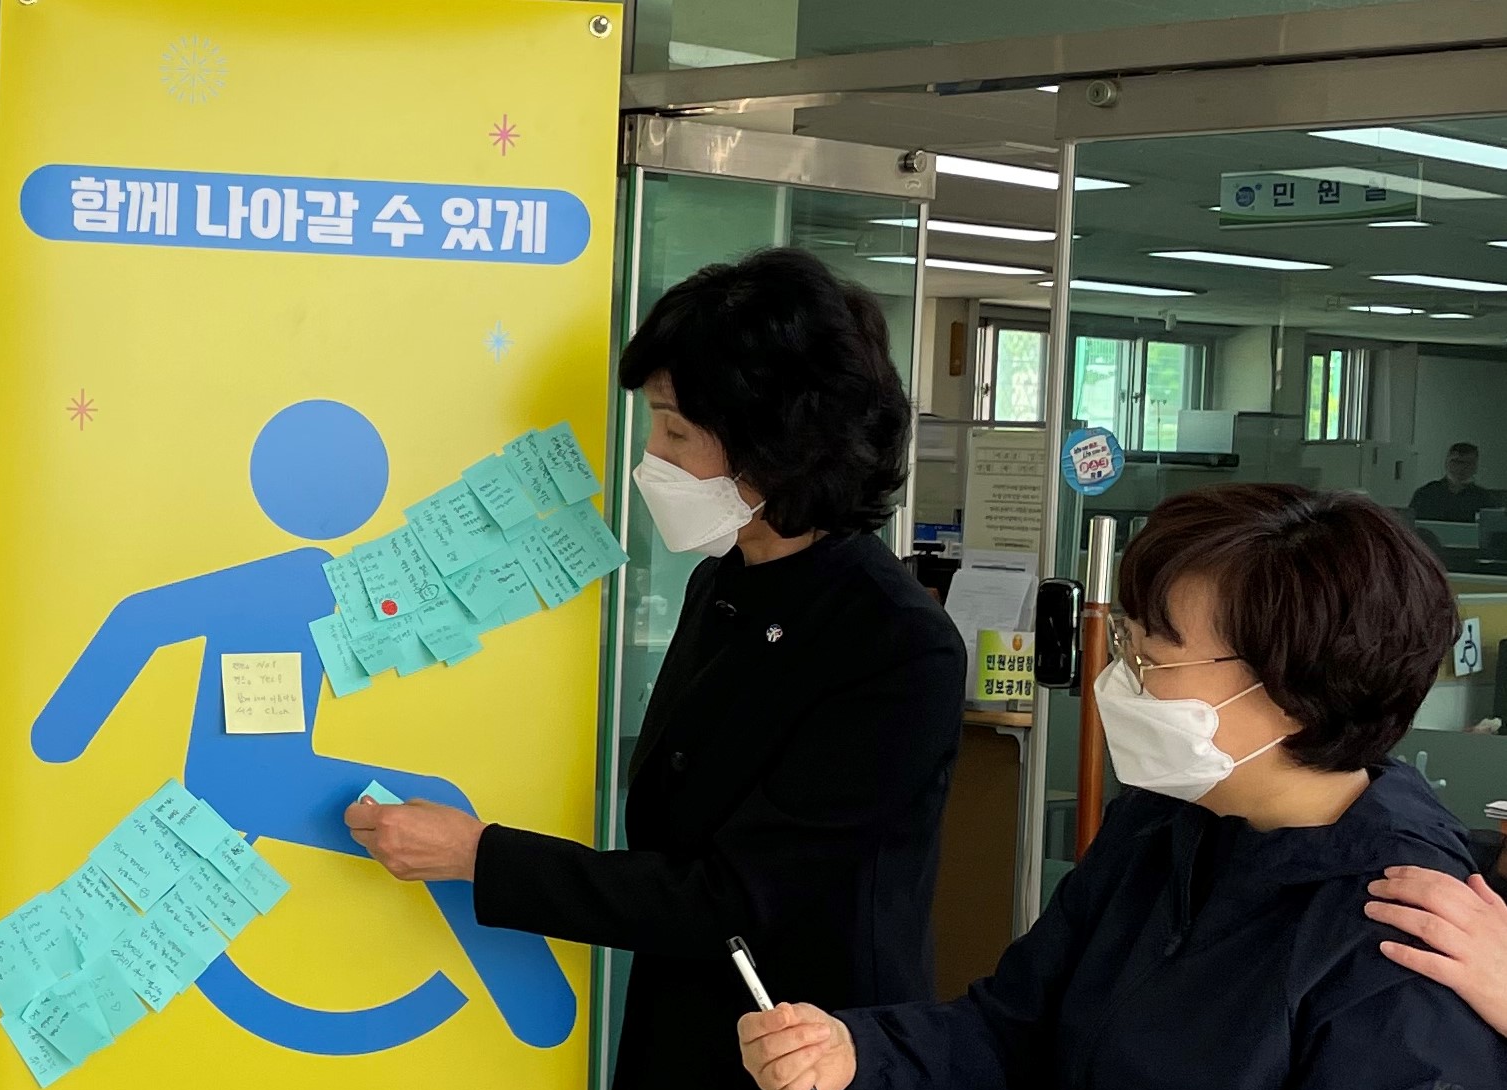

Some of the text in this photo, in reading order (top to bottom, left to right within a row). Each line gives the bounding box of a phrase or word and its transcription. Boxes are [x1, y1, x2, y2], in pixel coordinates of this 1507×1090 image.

[70, 176, 548, 255] 함께 나아갈 수 있게
[987, 655, 1033, 672] 민원상담창
[985, 679, 1032, 695] 정보공개창
